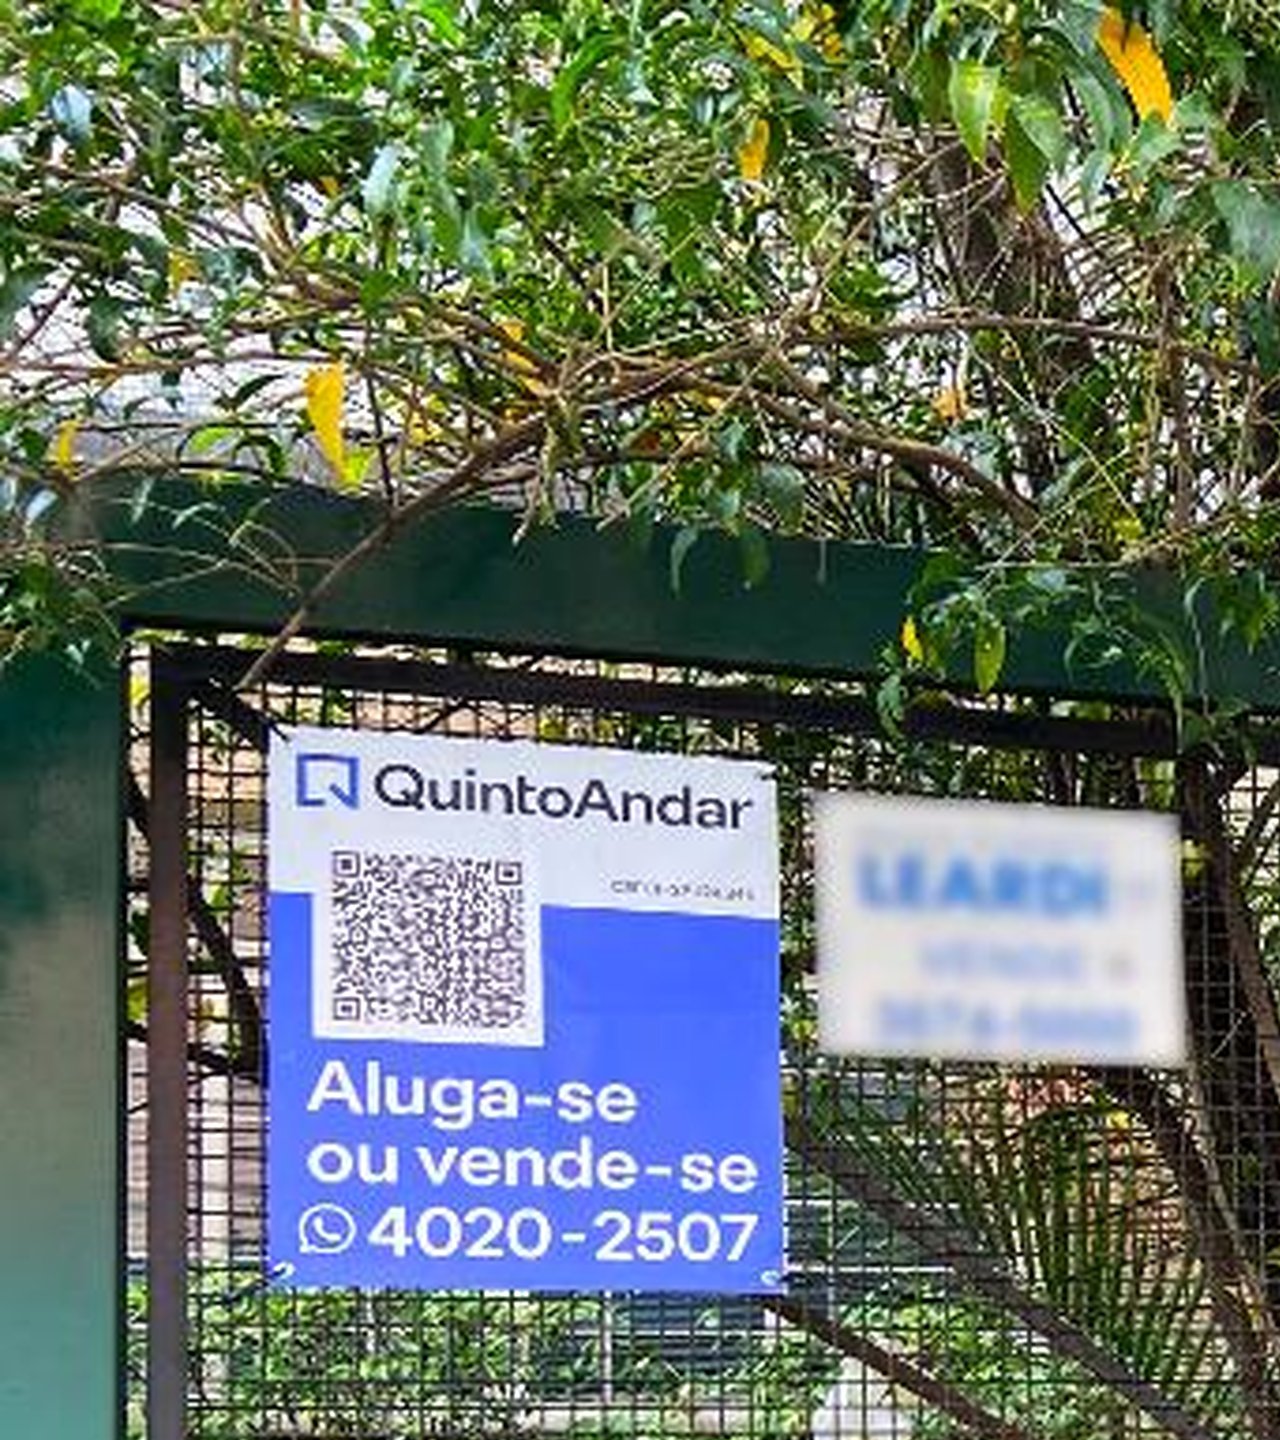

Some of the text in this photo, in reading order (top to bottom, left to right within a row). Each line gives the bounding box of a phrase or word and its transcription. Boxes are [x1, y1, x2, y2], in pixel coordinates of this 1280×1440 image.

[374, 763, 754, 831] QuintoAndar
[307, 1060, 639, 1131] Aluga-se
[307, 1136, 759, 1192] ou vende-se
[367, 1205, 760, 1262] 4020-2507
